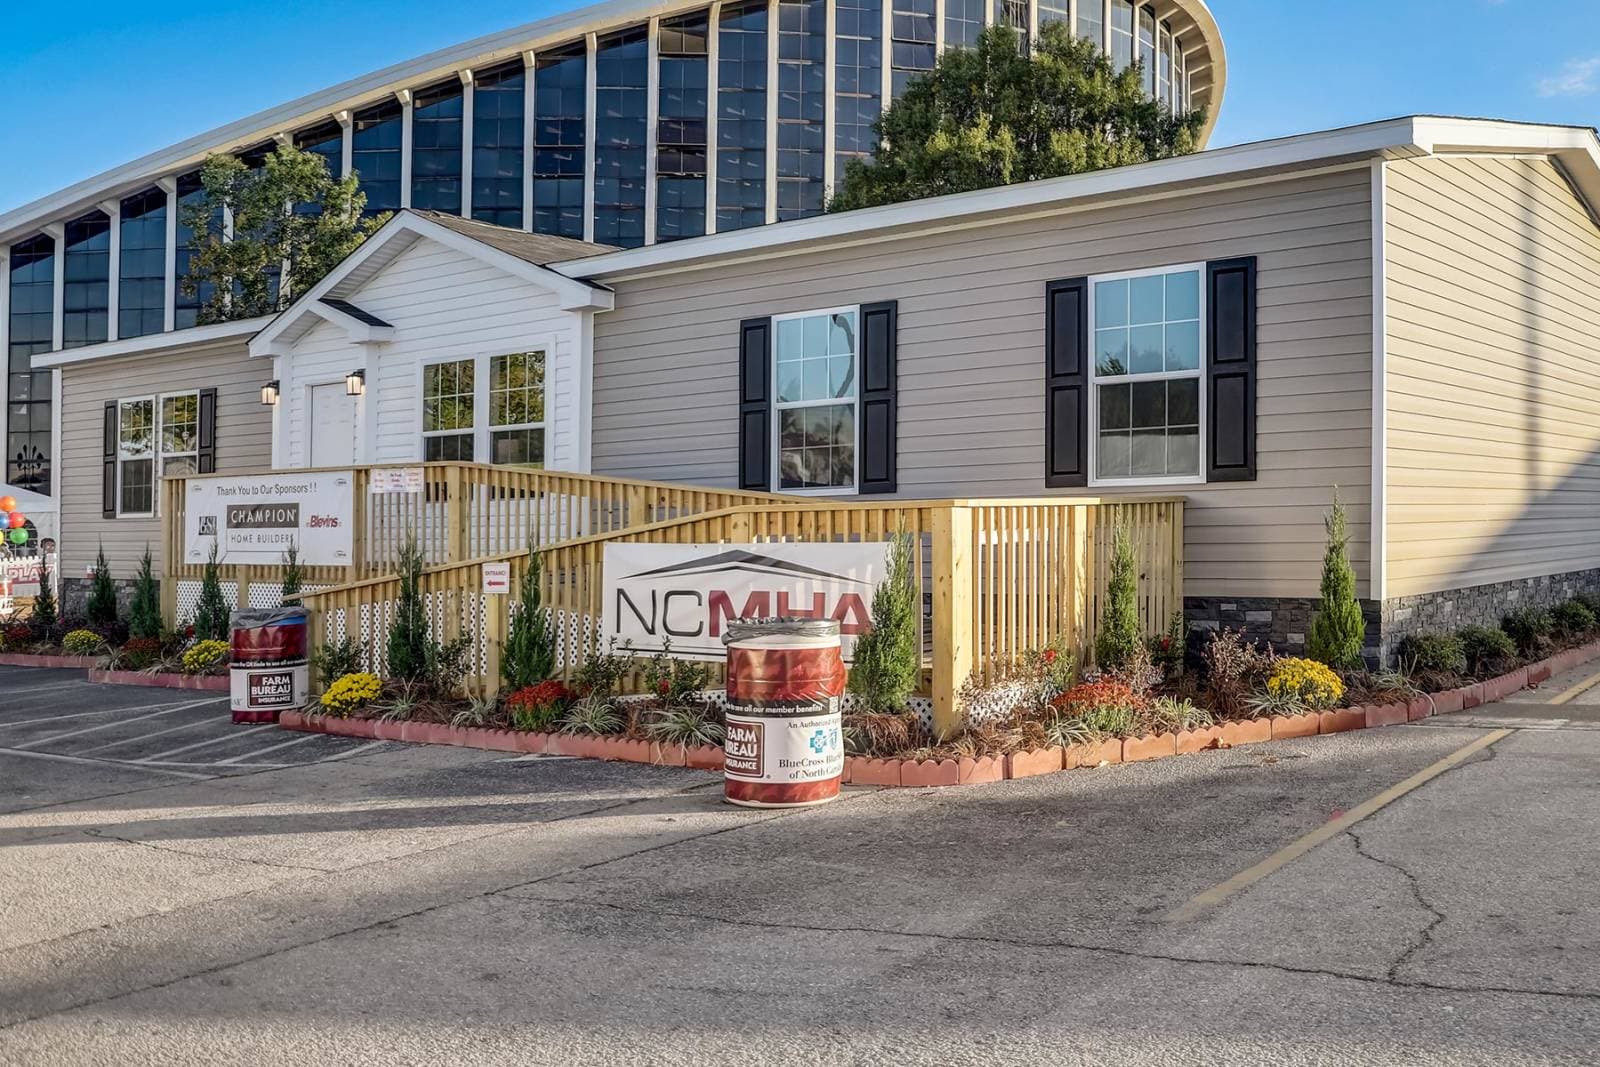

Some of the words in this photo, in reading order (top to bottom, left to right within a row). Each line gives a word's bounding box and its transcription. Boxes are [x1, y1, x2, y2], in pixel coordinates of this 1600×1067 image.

[217, 485, 236, 496] Thank
[238, 485, 250, 495] You
[252, 485, 258, 495] to
[260, 484, 273, 495] Our
[231, 509, 296, 523] CHAMPION
[310, 514, 338, 528] Blevins
[231, 534, 253, 544] HOME
[257, 534, 293, 544] BUILDER
[616, 588, 874, 638] NCMHA
[262, 675, 290, 686] FARM
[251, 685, 291, 695] BUREAU
[744, 704, 753, 712] all
[765, 705, 795, 713] member
[727, 726, 757, 742] FARM
[725, 739, 758, 757] UREAU
[778, 757, 825, 768] BlueCross
[789, 770, 800, 779] of
[801, 768, 825, 778] North
